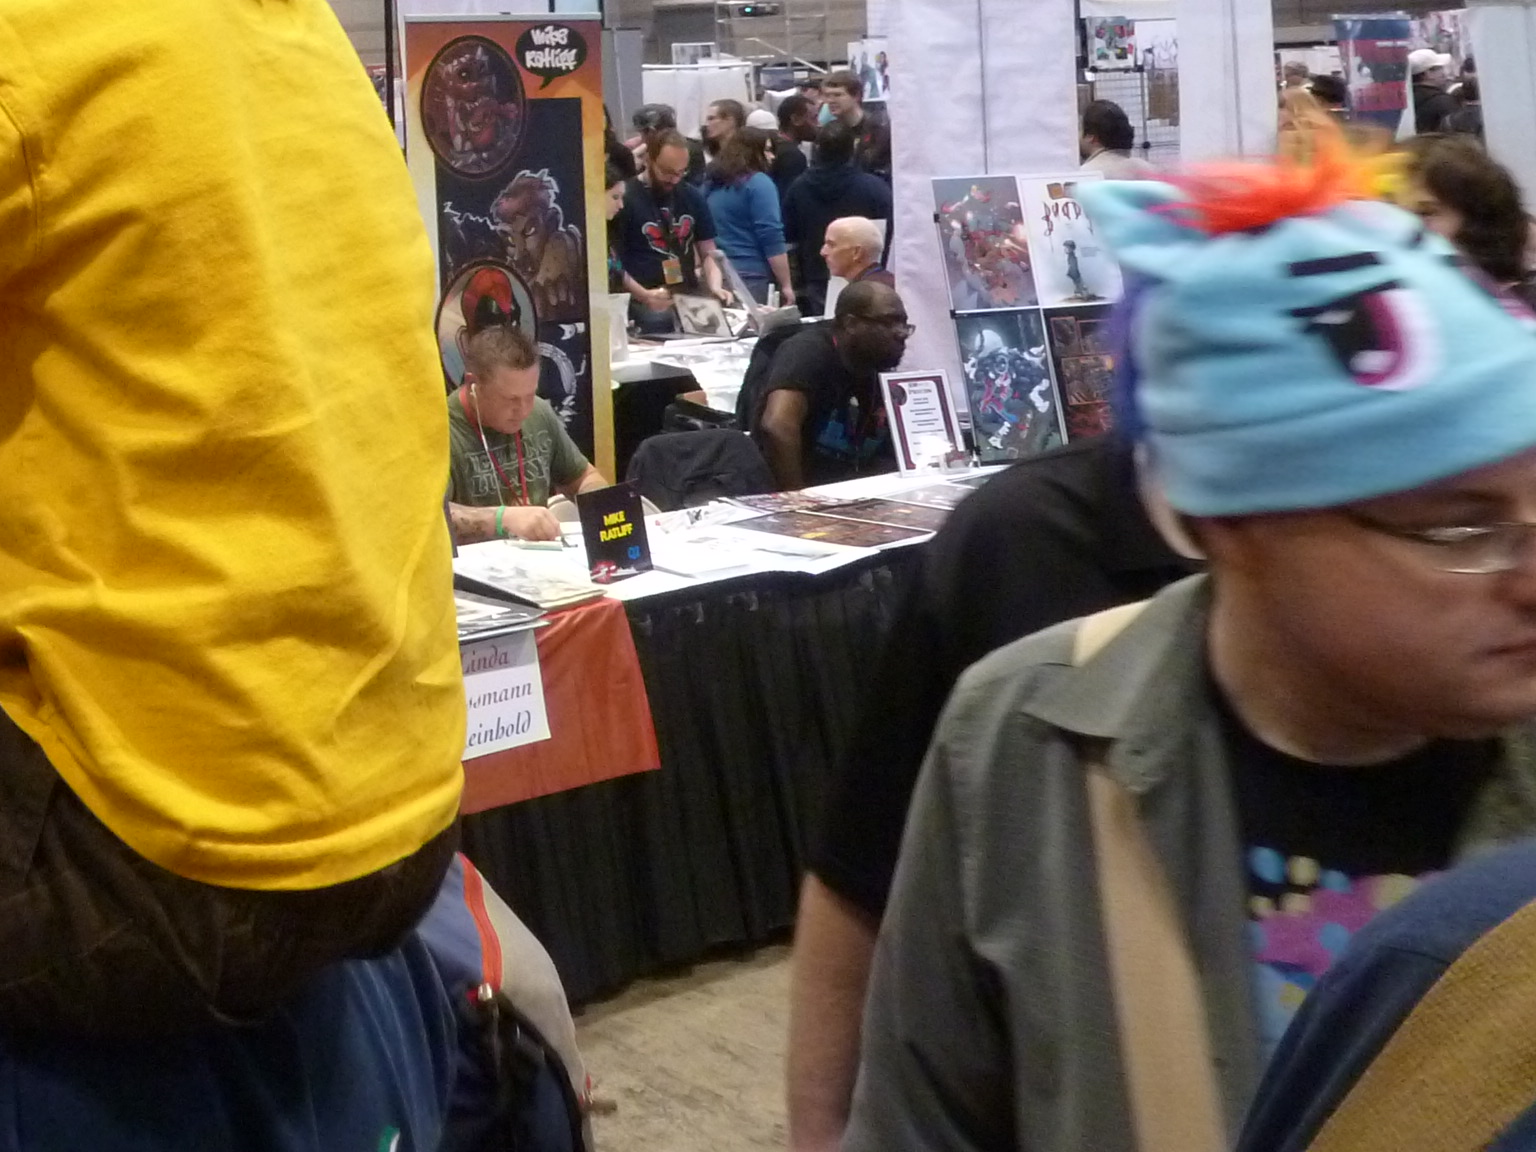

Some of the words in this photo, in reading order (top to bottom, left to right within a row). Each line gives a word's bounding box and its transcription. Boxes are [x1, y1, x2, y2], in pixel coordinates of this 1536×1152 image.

[602, 510, 626, 527] MIKE
[599, 522, 633, 543] RATLIFF
[467, 682, 533, 710] ssmann
[468, 709, 532, 747] einhold
